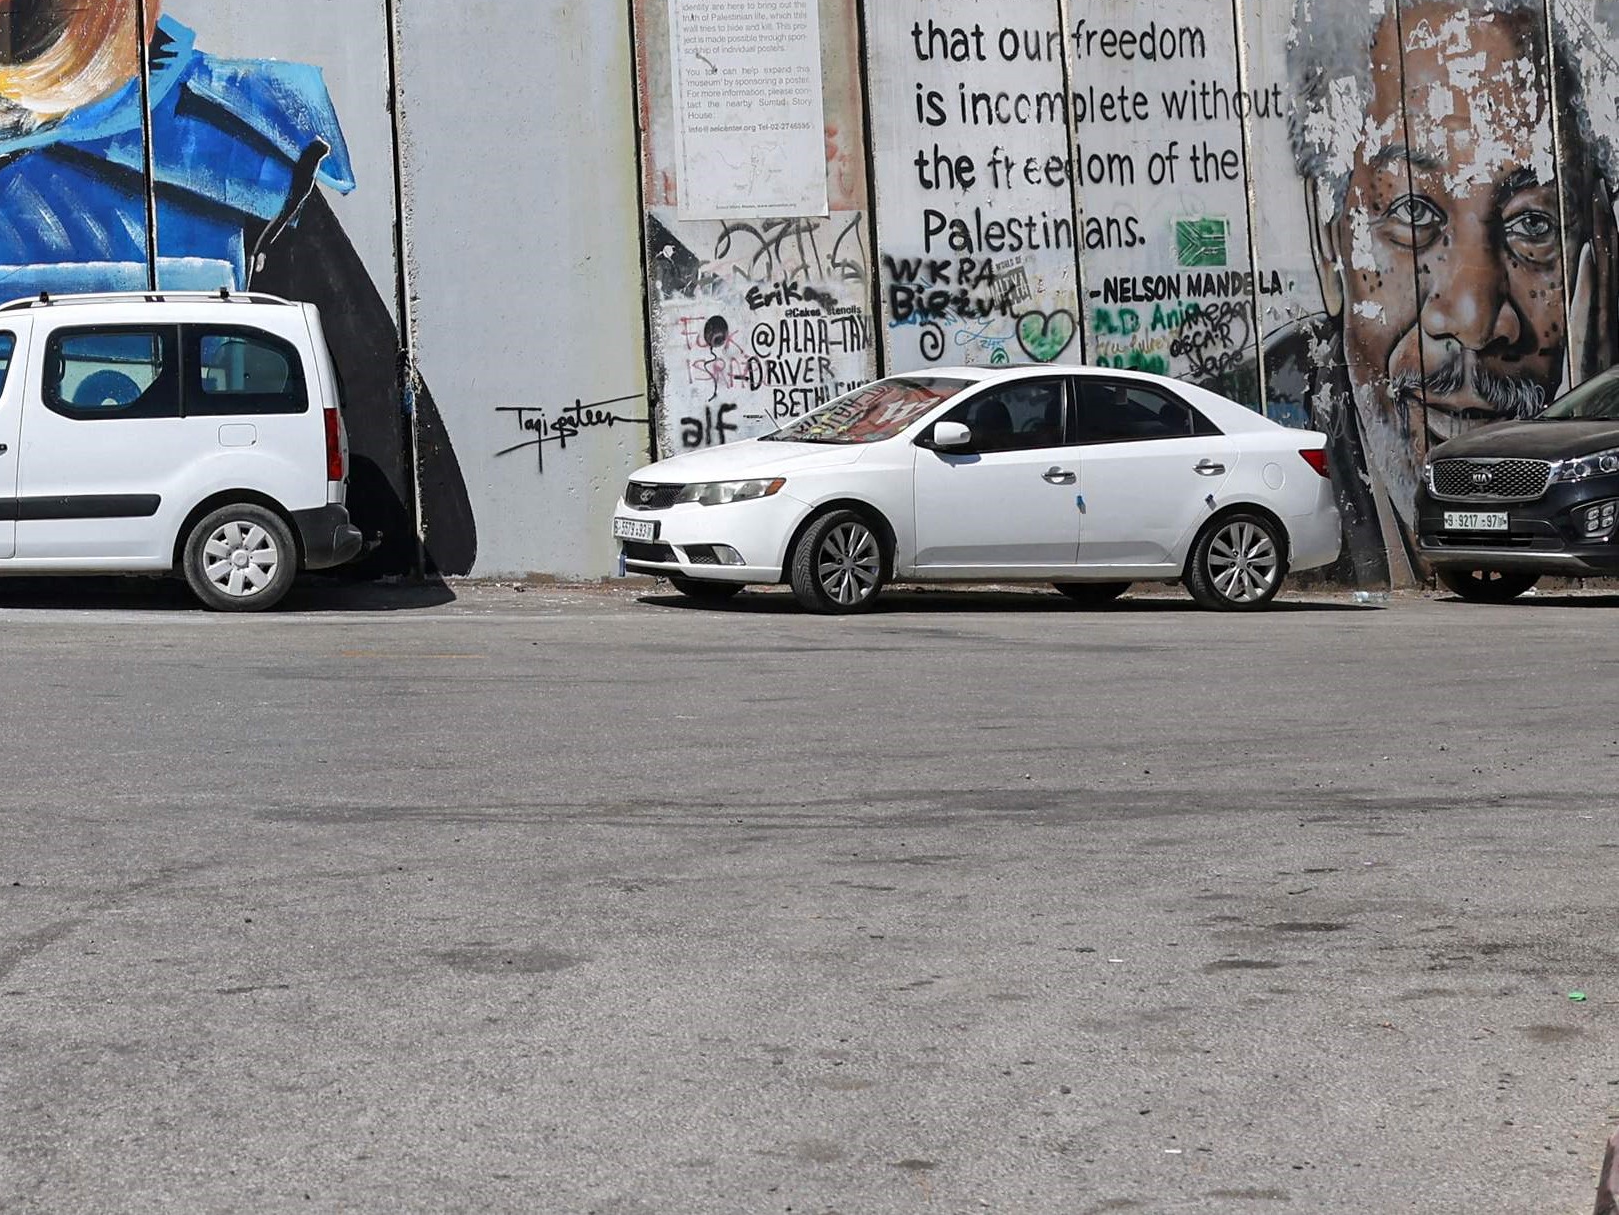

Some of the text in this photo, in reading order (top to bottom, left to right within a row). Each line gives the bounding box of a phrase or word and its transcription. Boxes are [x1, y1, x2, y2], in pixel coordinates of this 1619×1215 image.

[911, 19, 1207, 62] that our freedom
[915, 80, 1285, 133] is incomplete without
[914, 143, 977, 190] the
[1147, 142, 1180, 187] of
[1189, 140, 1240, 185] the
[1187, 270, 1283, 299] MANDELA
[1472, 473, 1488, 483] KIA
